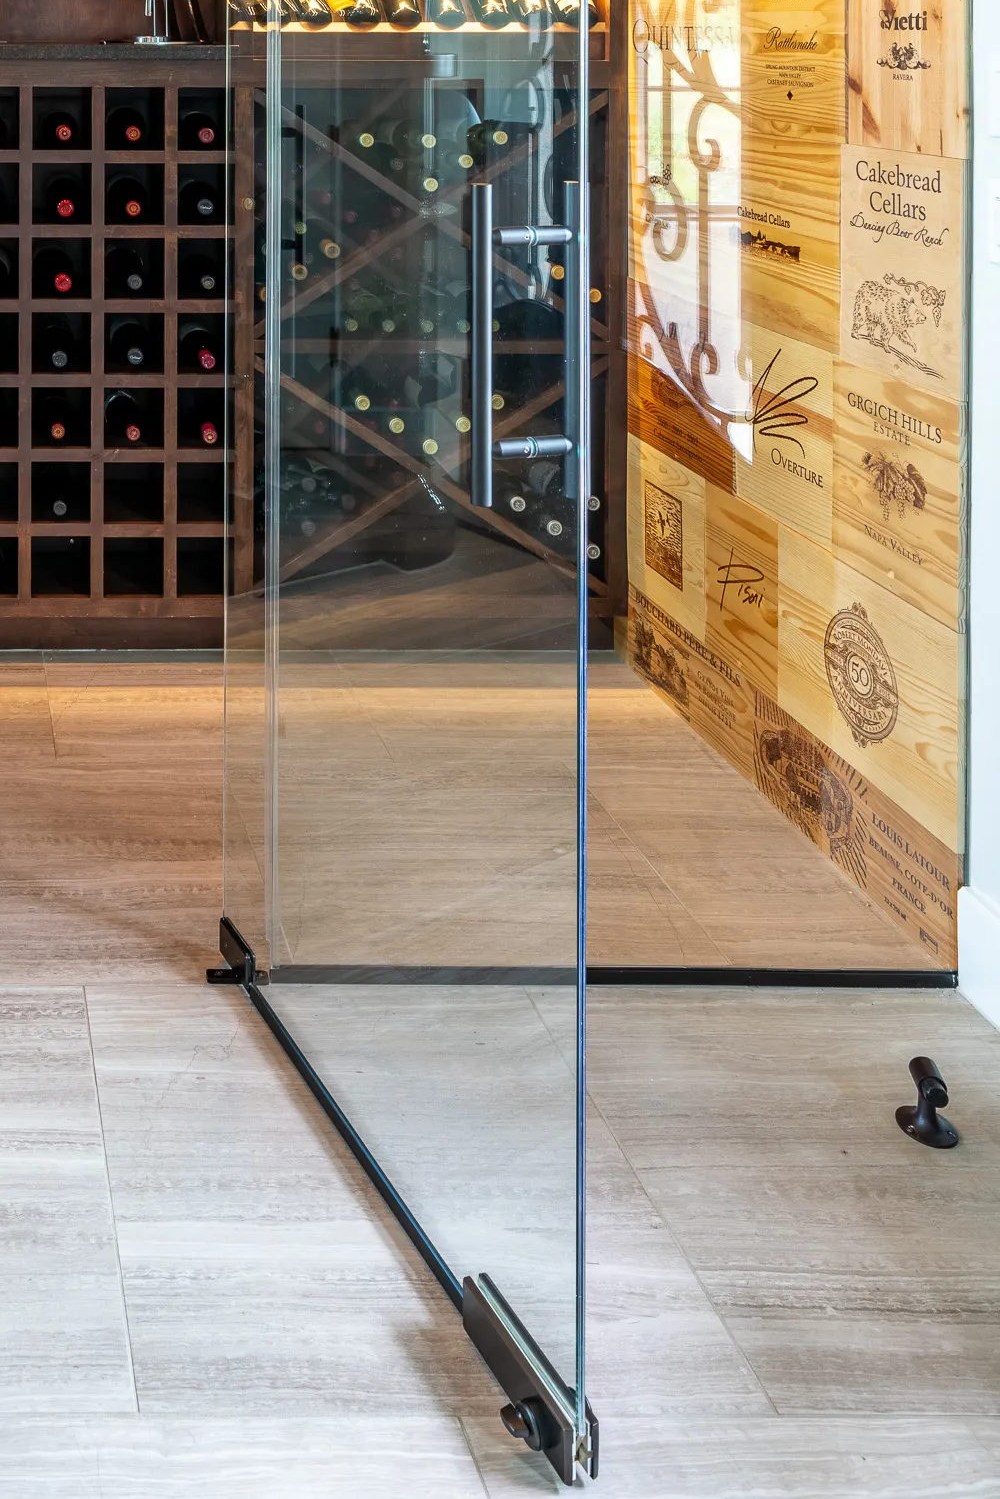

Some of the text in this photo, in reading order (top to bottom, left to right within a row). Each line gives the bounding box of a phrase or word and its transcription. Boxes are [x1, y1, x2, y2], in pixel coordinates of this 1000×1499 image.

[879, 9, 928, 30] Vietti
[763, 26, 818, 52] Rattlesnake
[892, 73, 914, 81] RAVERA
[856, 160, 942, 193] Cakebread
[737, 206, 791, 229] Cakebread Cellars
[869, 191, 926, 221] Cellars
[850, 211, 950, 247] Dancing Bear Ranch
[847, 392, 943, 444] GRGICH HILLS
[873, 421, 911, 447] ESTATE
[771, 448, 824, 488] OVERTURE
[864, 524, 924, 567] NAPA VALLEY
[635, 591, 682, 638] BOUCHARD
[709, 653, 718, 669] &
[719, 661, 741, 688] FILS
[851, 661, 869, 687] 50
[833, 675, 888, 721] ANNIVERSARY
[868, 835, 904, 875] BEAUNE,
[872, 812, 951, 891] LOUIS LATOUR
[892, 877, 927, 915] FRANCE
